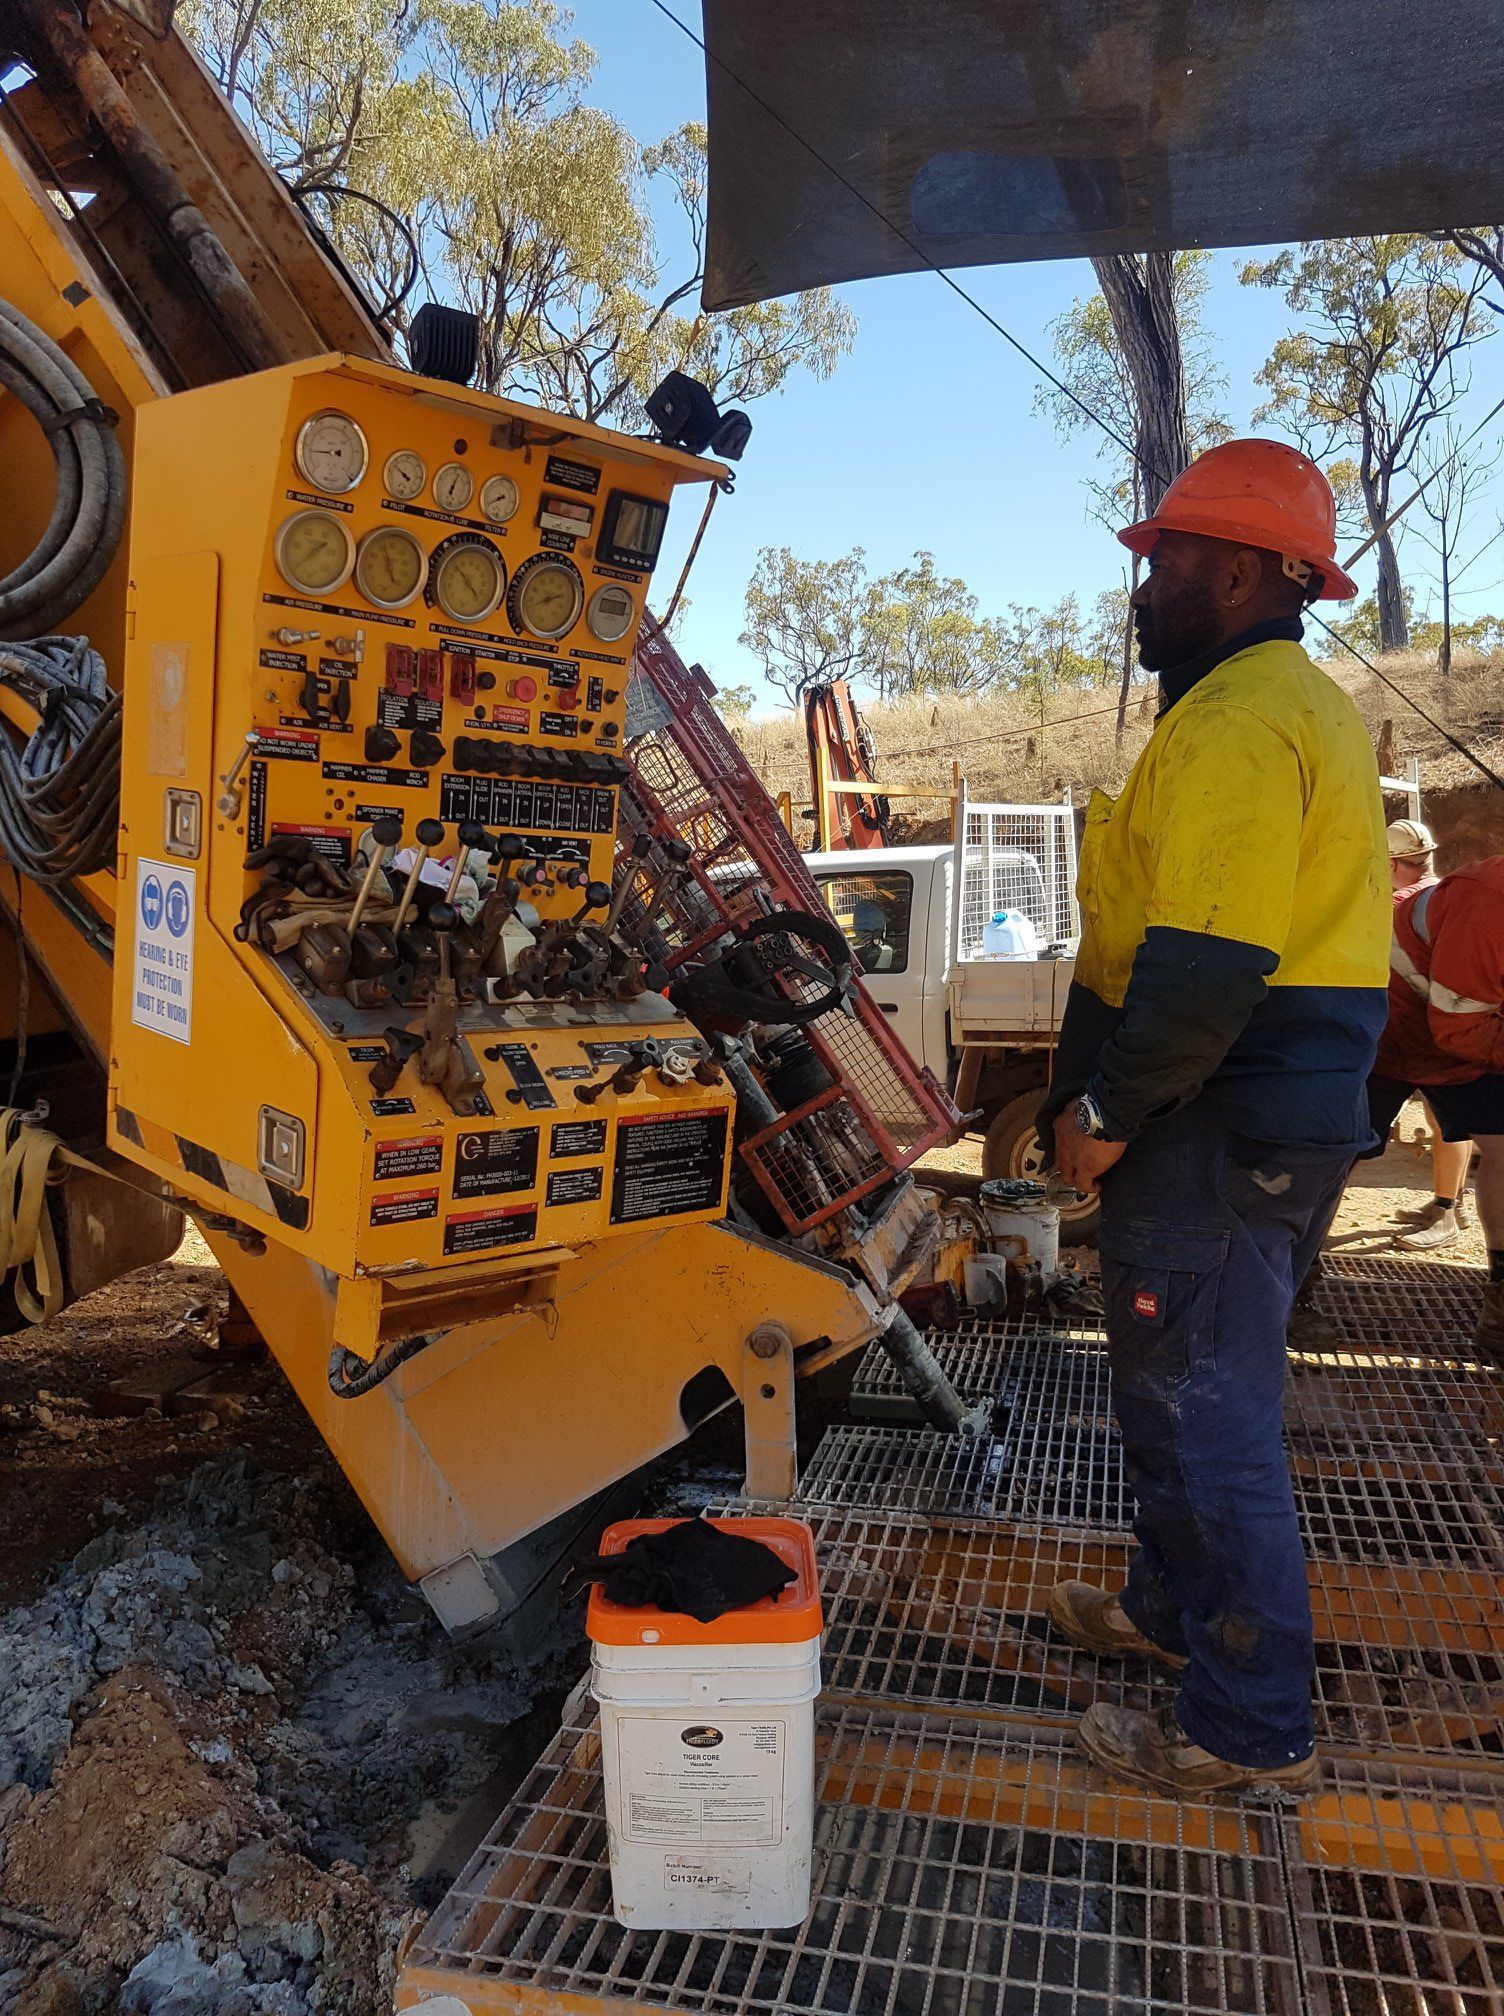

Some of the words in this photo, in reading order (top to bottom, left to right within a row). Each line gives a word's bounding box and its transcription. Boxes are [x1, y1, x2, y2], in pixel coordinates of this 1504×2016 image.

[296, 494, 315, 502] WATER
[316, 497, 345, 510] PRESSURE
[390, 502, 406, 511] PILOT
[424, 511, 450, 522] ROTATION
[296, 601, 323, 611] PRESSURE
[351, 610, 364, 619] MAIN
[365, 613, 380, 621] PUMP
[380, 615, 406, 625] PRESSURE
[438, 626, 450, 634] PULL
[450, 628, 466, 637] DOWN
[466, 631, 489, 640] PRESSURE
[503, 638, 516, 646] HOLD
[529, 642, 550, 651] PRESSURE
[267, 653, 286, 661] WATER
[449, 645, 471, 655] IGNITION
[475, 649, 496, 659] STARTER
[269, 660, 298, 670] INJECTION
[553, 663, 574, 672] THROTTLE
[325, 668, 353, 677] INJECTION
[380, 694, 408, 702] ISOLATION
[414, 699, 440, 707] ISOLATION
[499, 708, 525, 716] EMERGENCY
[274, 730, 301, 738] WARNING
[258, 745, 291, 754] SUSPENDED
[292, 748, 315, 756] OBJECTS
[139, 940, 166, 964] HEARING
[169, 950, 173, 966] &
[176, 952, 188, 971] EYE
[142, 968, 183, 996] PROTECTION
[137, 991, 155, 1012] MUST
[157, 998, 166, 1016] BE
[167, 1002, 187, 1025] WORN
[382, 1151, 398, 1159] WHEN
[421, 1146, 437, 1154] GEAR,
[390, 1156, 417, 1165] ROTATION
[419, 1153, 440, 1161] TORQUE
[389, 1164, 415, 1173] MAXIMUM
[461, 1174, 476, 1182] SERIAL
[393, 1192, 420, 1200] WARNING
[483, 1209, 504, 1217] DANGER
